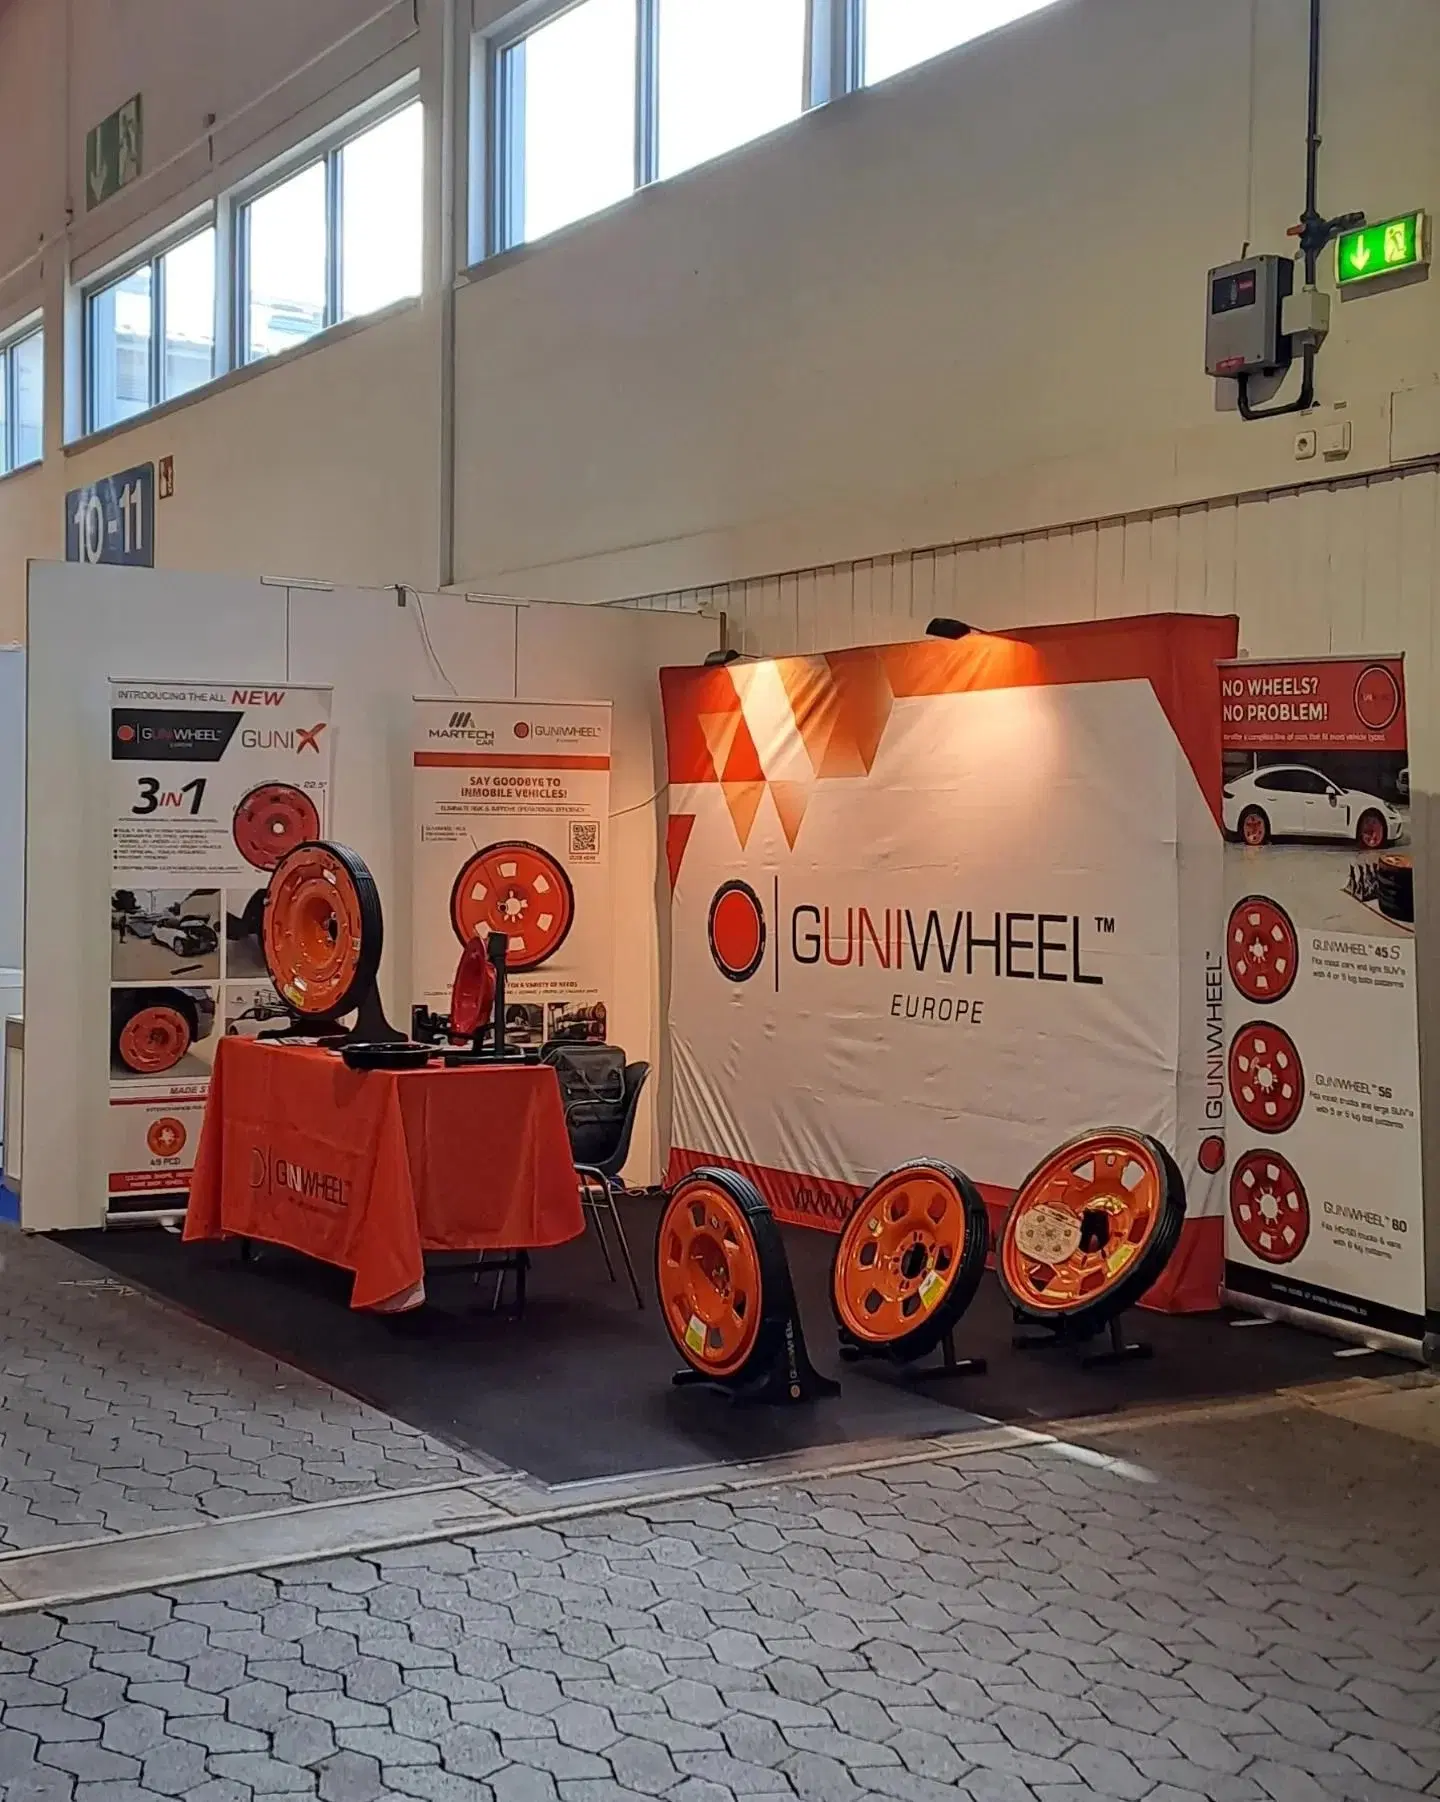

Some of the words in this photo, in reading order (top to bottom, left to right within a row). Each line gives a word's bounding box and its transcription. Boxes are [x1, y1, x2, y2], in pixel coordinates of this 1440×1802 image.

[1223, 679, 1244, 696] NO
[1248, 677, 1319, 696] WHEELS?
[117, 690, 186, 701] INTRODUCING
[188, 692, 208, 702] THE
[209, 692, 226, 702] ALL
[231, 690, 285, 706] NEW
[1223, 704, 1244, 721] NO
[1248, 702, 1328, 721] PROBLEM!
[428, 728, 495, 740] MARTECH
[469, 776, 490, 786] SAY
[493, 776, 544, 787] GOODBYE
[547, 777, 561, 787] TO
[515, 789, 568, 799] VEHICLES!
[891, 994, 984, 1024] EUROPE
[169, 1086, 198, 1094] MADE
